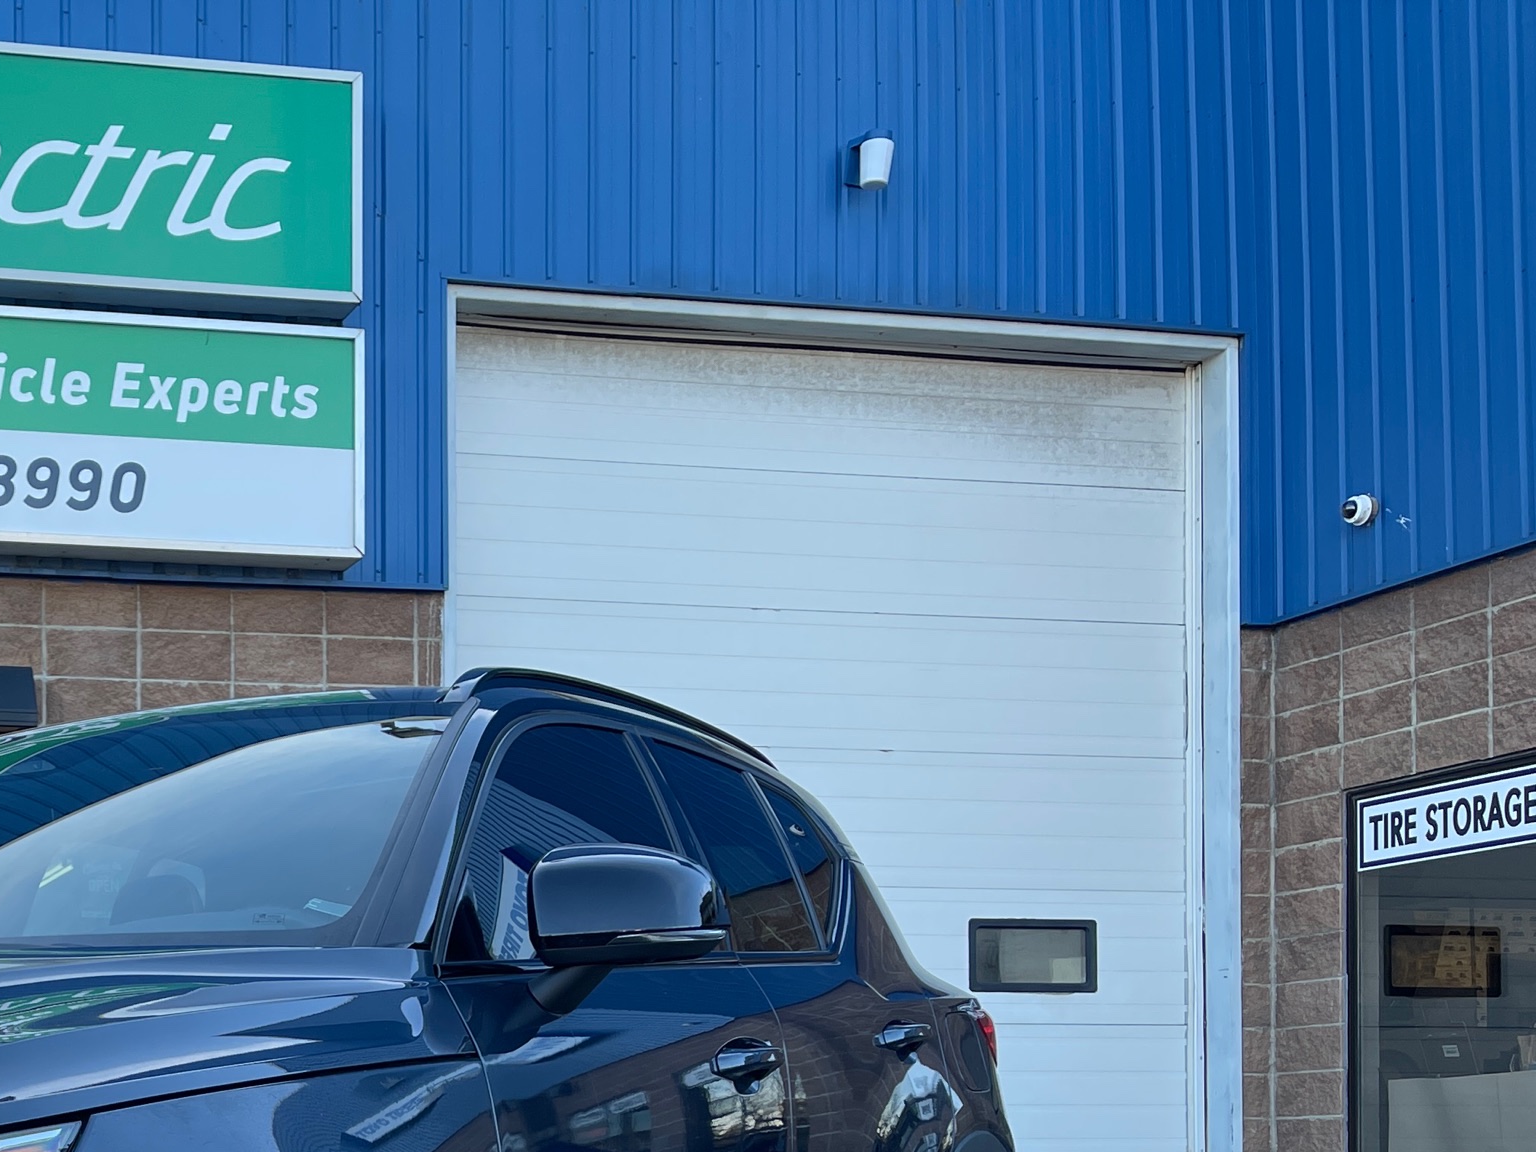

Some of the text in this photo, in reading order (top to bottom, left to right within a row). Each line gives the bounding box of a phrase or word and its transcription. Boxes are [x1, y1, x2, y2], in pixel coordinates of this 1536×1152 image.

[109, 361, 320, 423] Experts
[1368, 784, 1536, 851] TIRE STORAGE
